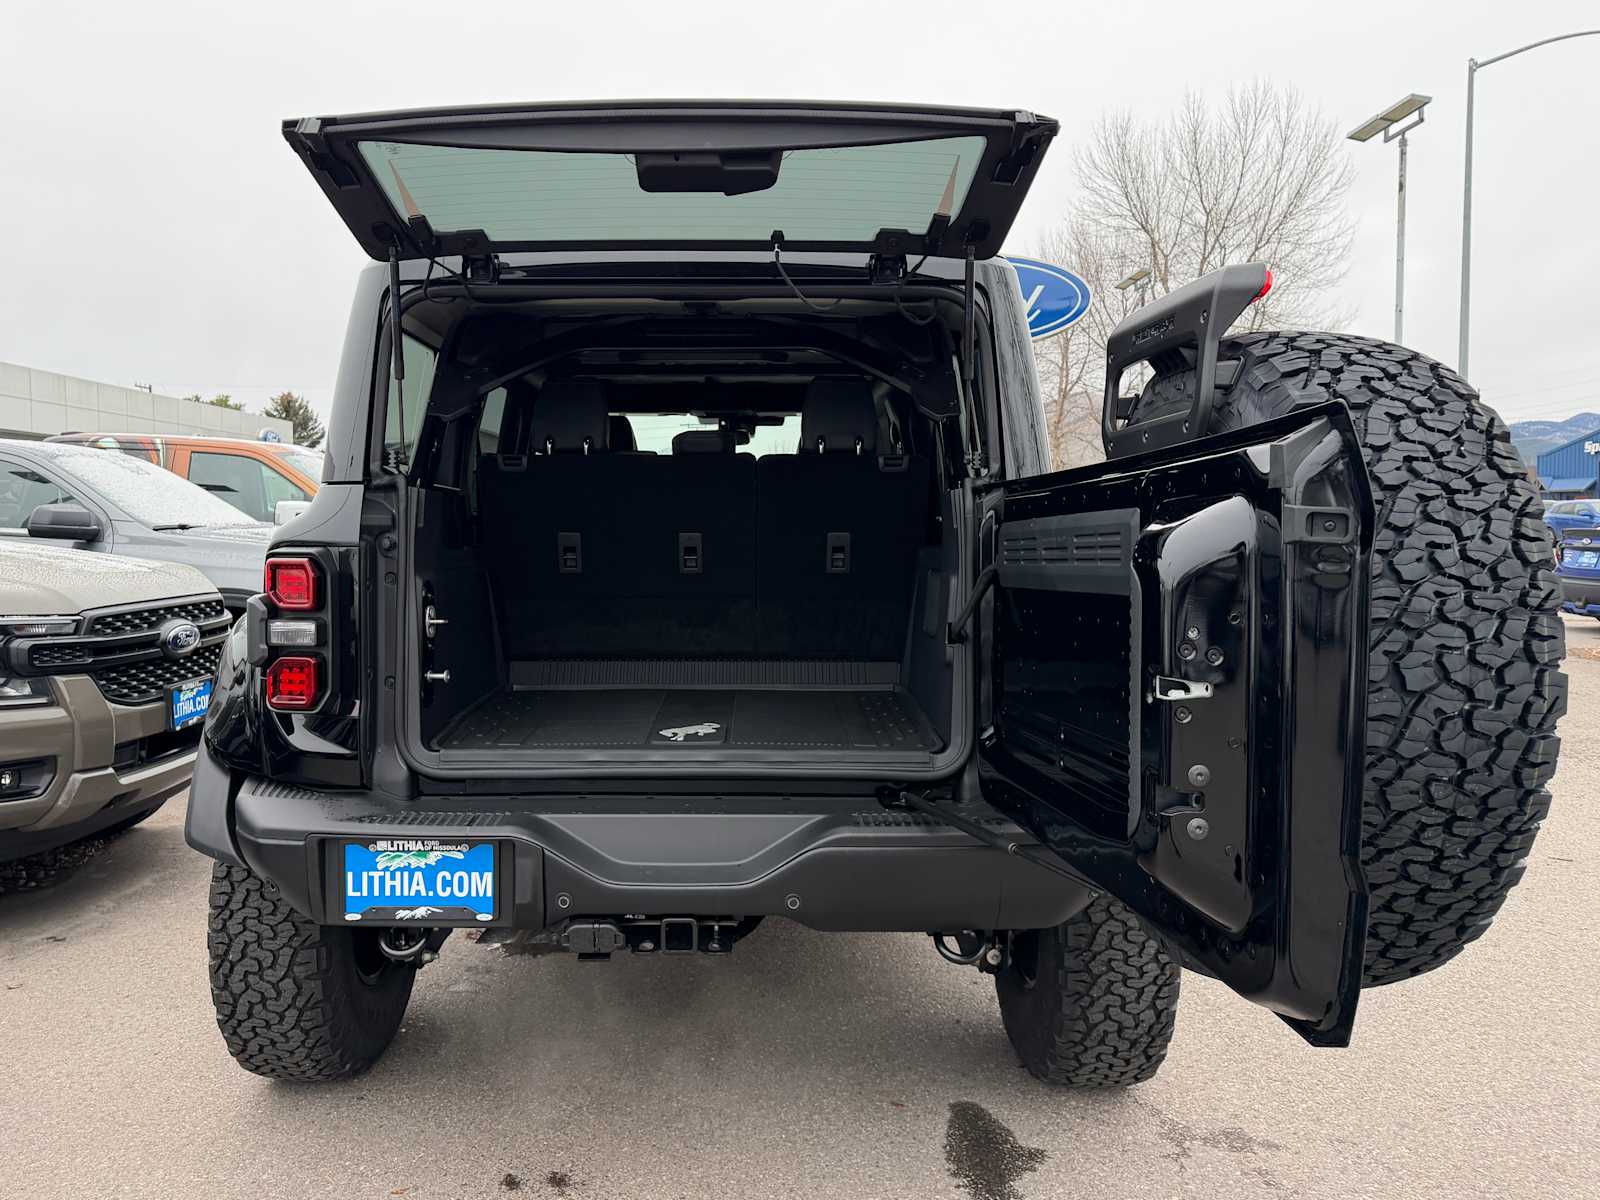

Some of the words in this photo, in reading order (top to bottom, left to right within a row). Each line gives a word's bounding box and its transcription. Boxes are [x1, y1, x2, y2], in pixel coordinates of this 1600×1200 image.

[1584, 441, 1600, 455] Sp
[388, 840, 424, 851] LITHIA
[347, 871, 493, 897] LITHIA.COM
